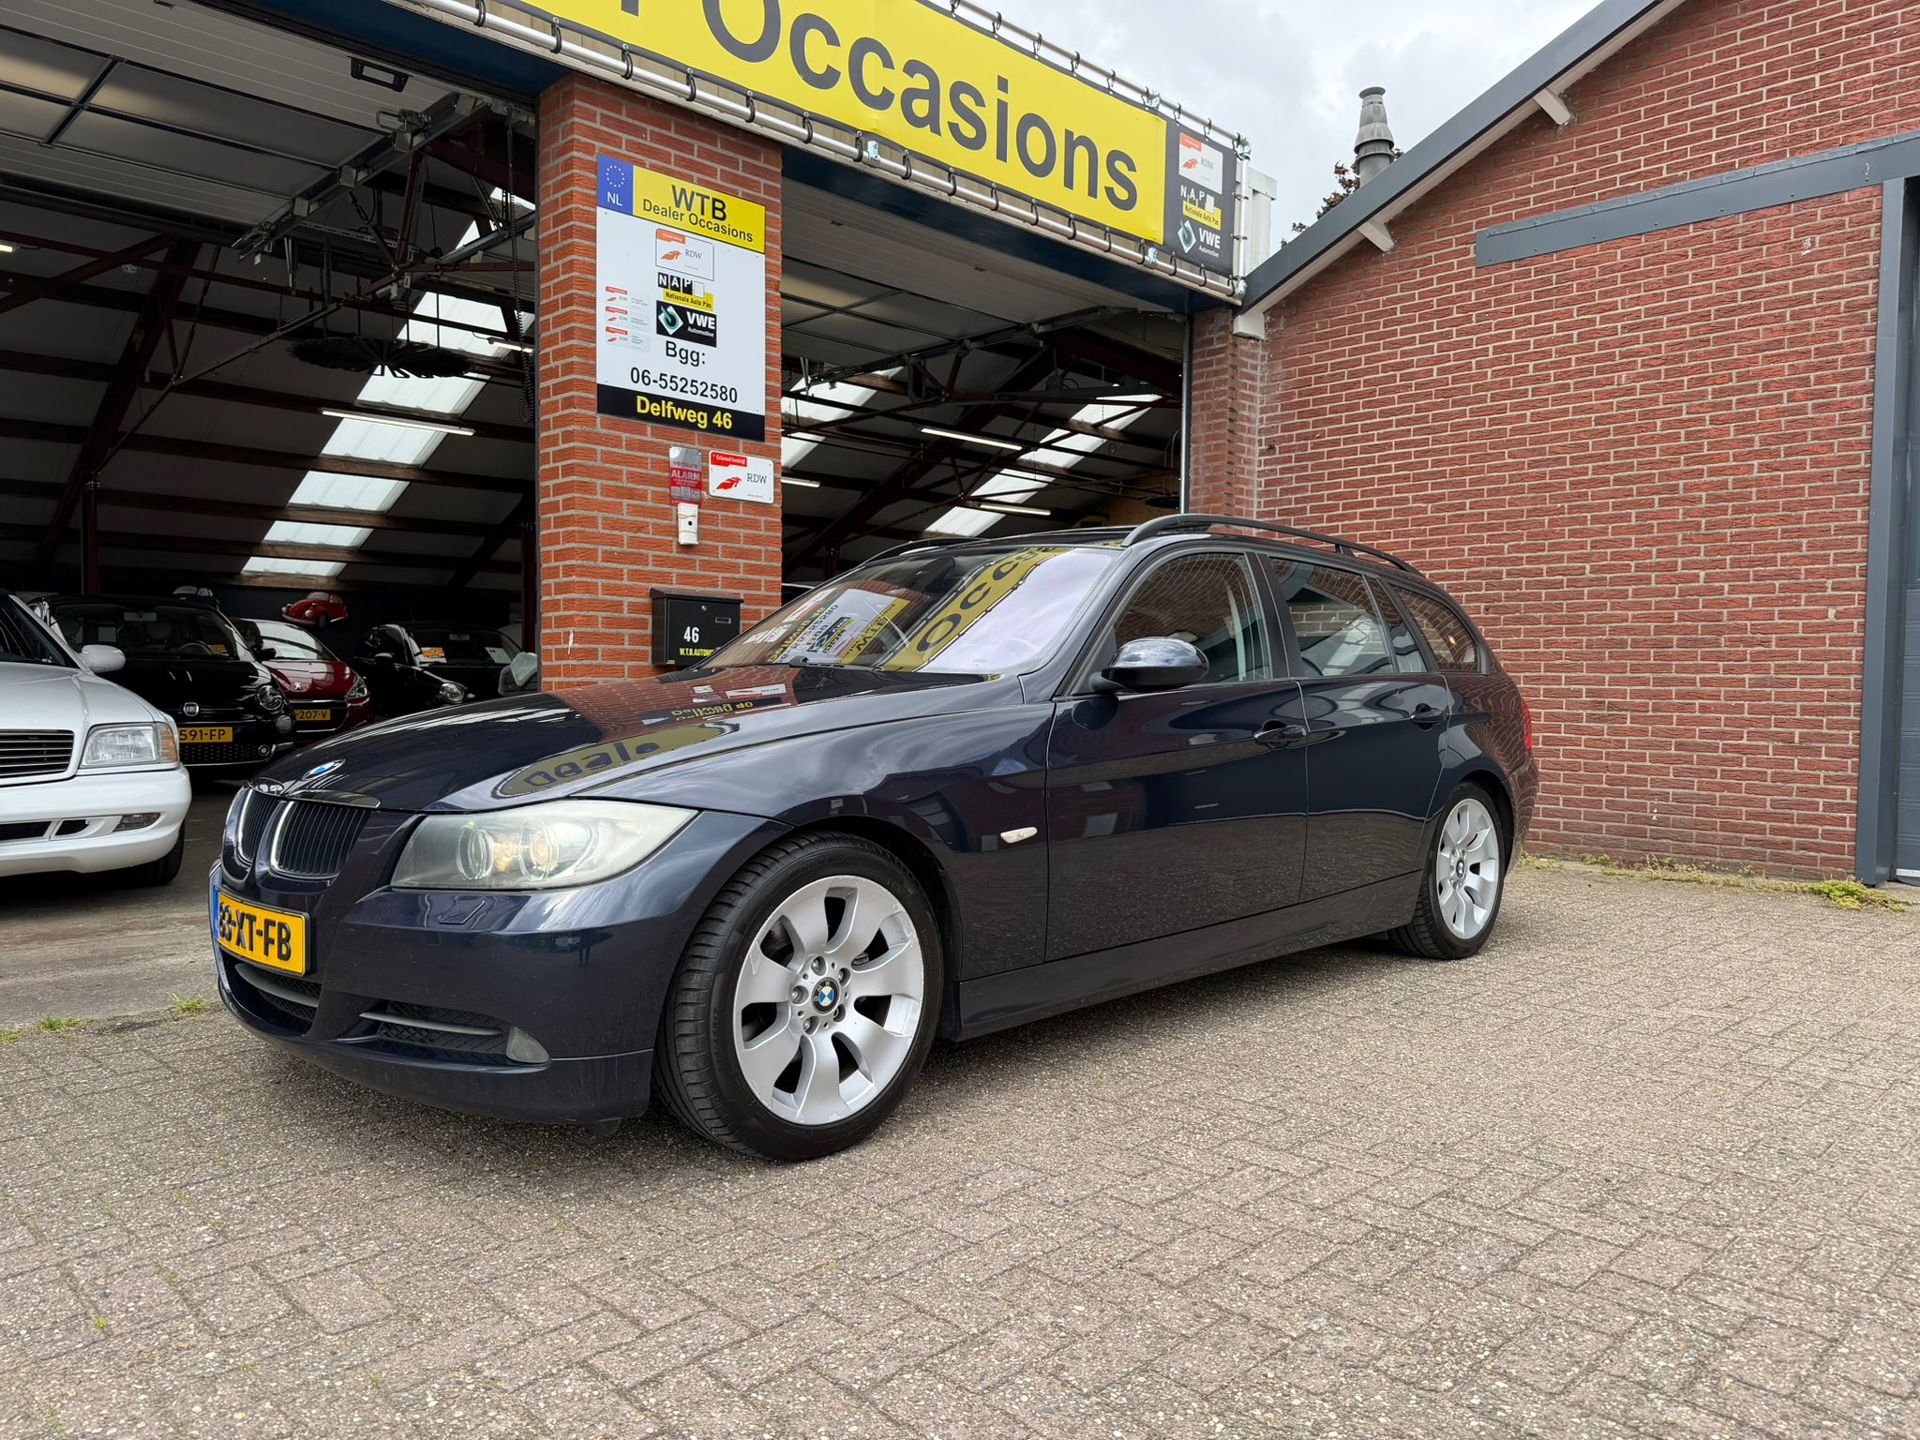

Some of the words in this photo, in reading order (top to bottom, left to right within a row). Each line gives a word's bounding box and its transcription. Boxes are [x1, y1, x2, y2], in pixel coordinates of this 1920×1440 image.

[703, 0, 1138, 211] Occasions
[606, 191, 623, 207] NL
[671, 184, 728, 222] WTB
[642, 198, 685, 223] Dealer
[688, 212, 754, 243] Occasions
[1199, 227, 1221, 250] VWE
[685, 248, 703, 260] RDW
[686, 310, 716, 330] VWE
[665, 340, 706, 367] Bgg:
[630, 366, 738, 404] 06-55252580
[636, 394, 708, 429] Delfweg
[712, 410, 733, 431] 46
[671, 469, 701, 481] ALARM
[746, 472, 768, 485] RDW
[683, 625, 700, 643] 46
